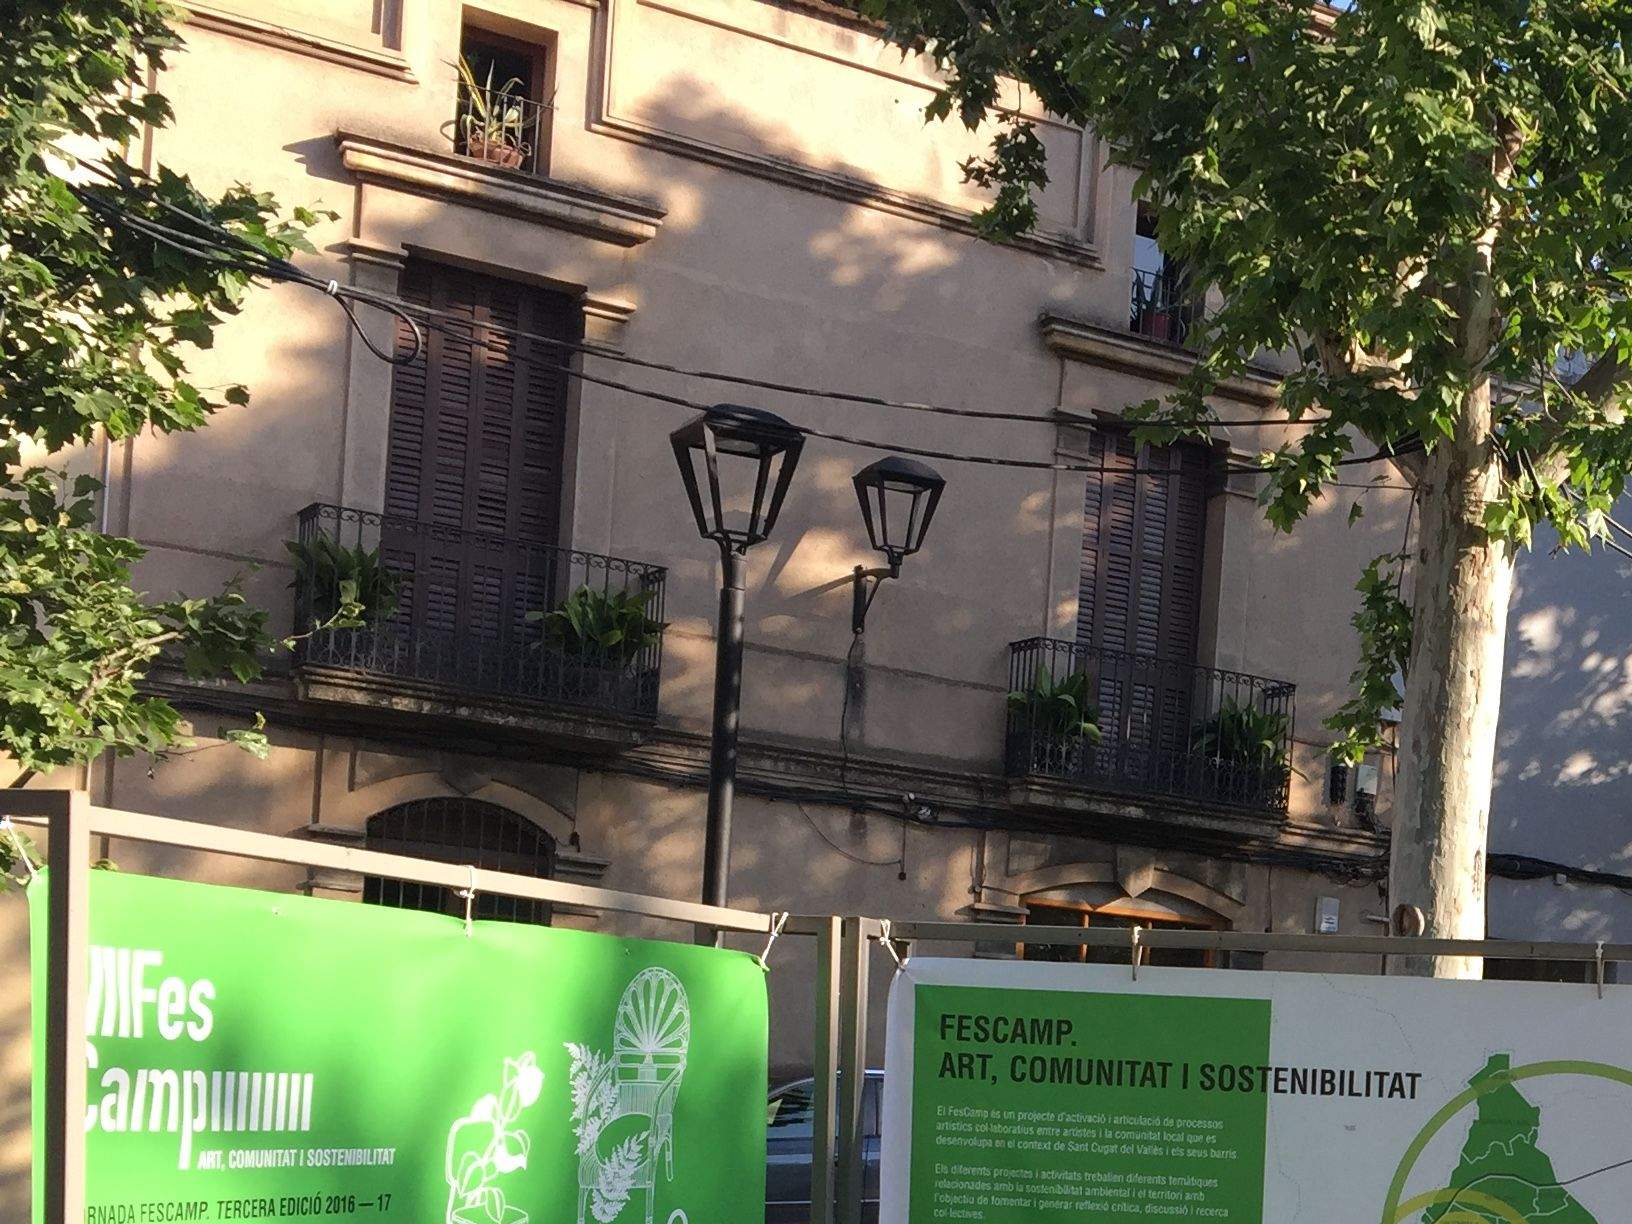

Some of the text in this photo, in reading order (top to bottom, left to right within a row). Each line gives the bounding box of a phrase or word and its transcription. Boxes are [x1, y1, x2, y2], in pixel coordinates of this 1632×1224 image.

[939, 1013, 1077, 1048] FESCAMP.
[938, 1052, 1422, 1100] ART, COMUNITAT I SOSTENIBILITAT
[199, 1149, 225, 1171] ART,
[228, 1149, 297, 1170] COMUNITAT
[306, 1147, 396, 1168] SOSTENIBILITAT
[140, 1200, 209, 1224] FESCAMP.
[217, 1198, 276, 1220] TERCERA
[279, 1191, 322, 1217] EDICIÓ
[325, 1195, 355, 1214] 2016
[377, 1193, 392, 1212] 17
